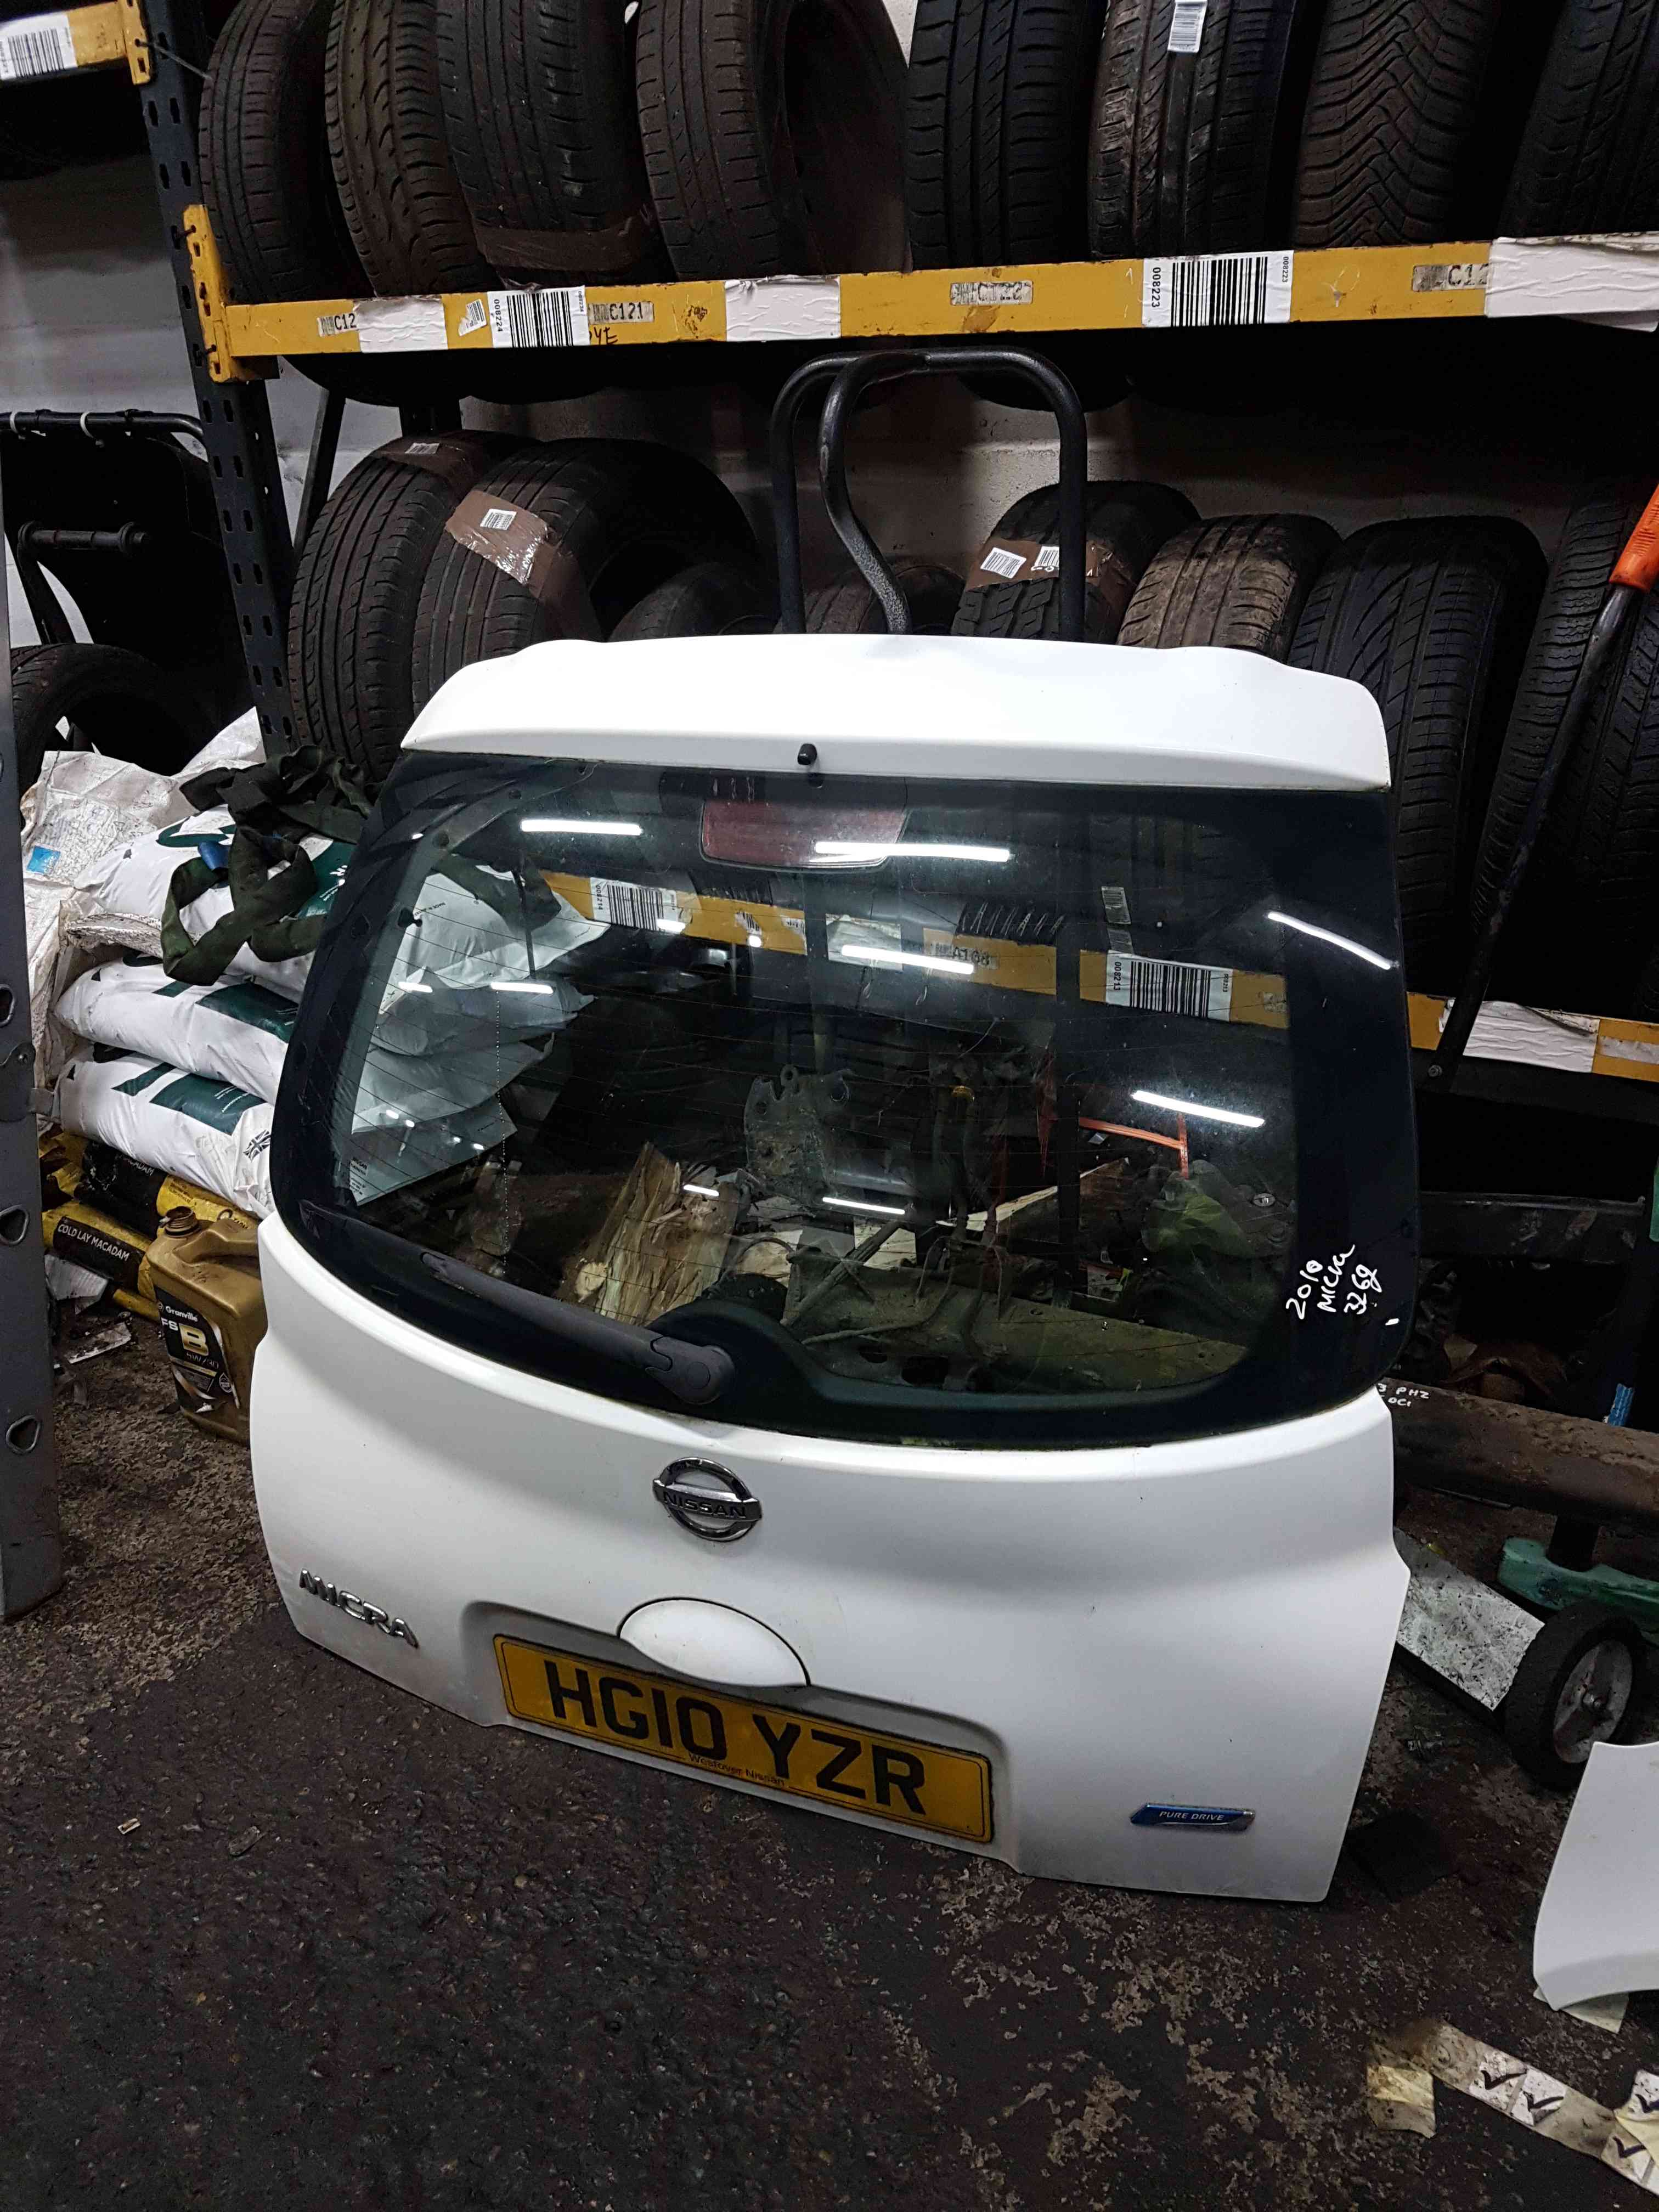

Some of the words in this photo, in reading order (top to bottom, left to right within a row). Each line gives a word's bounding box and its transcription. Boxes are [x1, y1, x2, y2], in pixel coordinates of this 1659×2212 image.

[1152, 267, 1161, 308] 008223
[494, 298, 503, 332] 008224
[610, 302, 643, 320] C121
[1113, 961, 1122, 991] 008213
[58, 1223, 77, 1237] COLD
[77, 1229, 92, 1242] LAY
[91, 1236, 130, 1261] MACADAM
[1286, 1260, 1323, 1319] 2010
[165, 1306, 198, 1322] Granville
[663, 1491, 747, 1519] NISSAN
[299, 1569, 419, 1650] MICRA
[544, 1661, 727, 1761] HG10
[753, 1714, 926, 1815] YZR
[746, 1768, 785, 1787] Nissan
[1159, 1811, 1189, 1820] PURE
[1191, 1813, 1225, 1821] DRIVE
